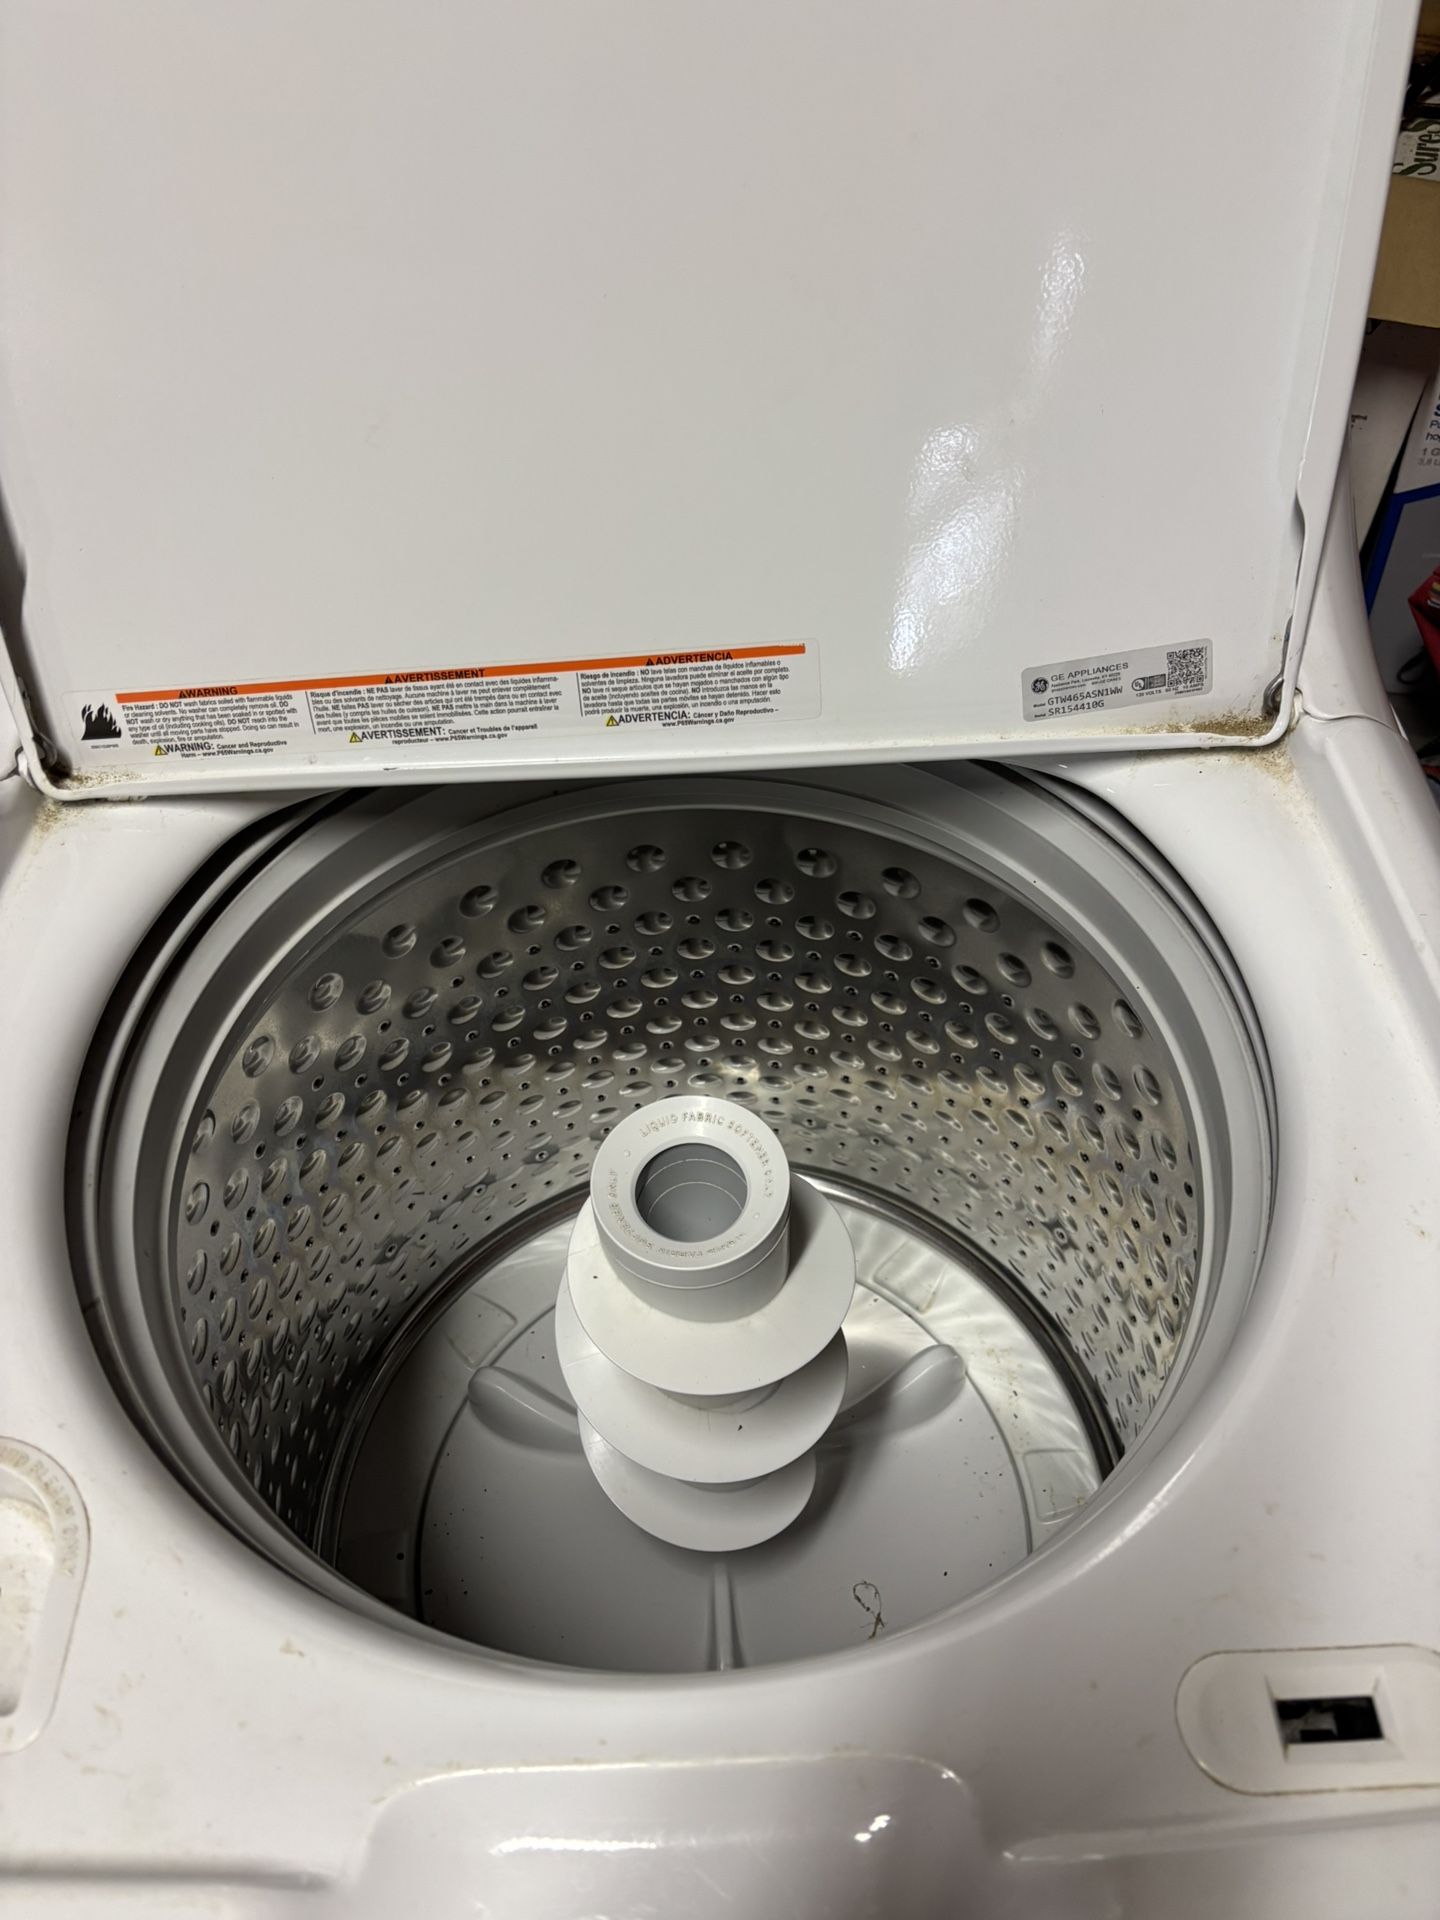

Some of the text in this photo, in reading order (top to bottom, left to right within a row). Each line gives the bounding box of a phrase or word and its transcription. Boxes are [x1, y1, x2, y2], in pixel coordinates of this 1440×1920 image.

[655, 651, 732, 665] ADVERTENCIA
[393, 668, 486, 683] AVERTISSEMENT
[580, 672, 600, 680] Riesgo
[1051, 673, 1064, 682] GE
[1067, 662, 1129, 679] APPLIANCES
[185, 686, 238, 697] WARNING
[331, 688, 361, 696] d'incendie
[1047, 686, 1123, 706] GTW465ASN1WW
[617, 709, 690, 723] ADVERTENCIA:
[735, 707, 774, 716] Reproductivo
[1048, 700, 1105, 717] SR154410G
[360, 726, 445, 740] AVERTISSEMENT:
[164, 741, 214, 752] WARNING:
[249, 739, 287, 748] Reproductive
[639, 1114, 679, 1138] LIQUID
[682, 1110, 724, 1126] FABRIC
[727, 1120, 770, 1168] SOFTENER
